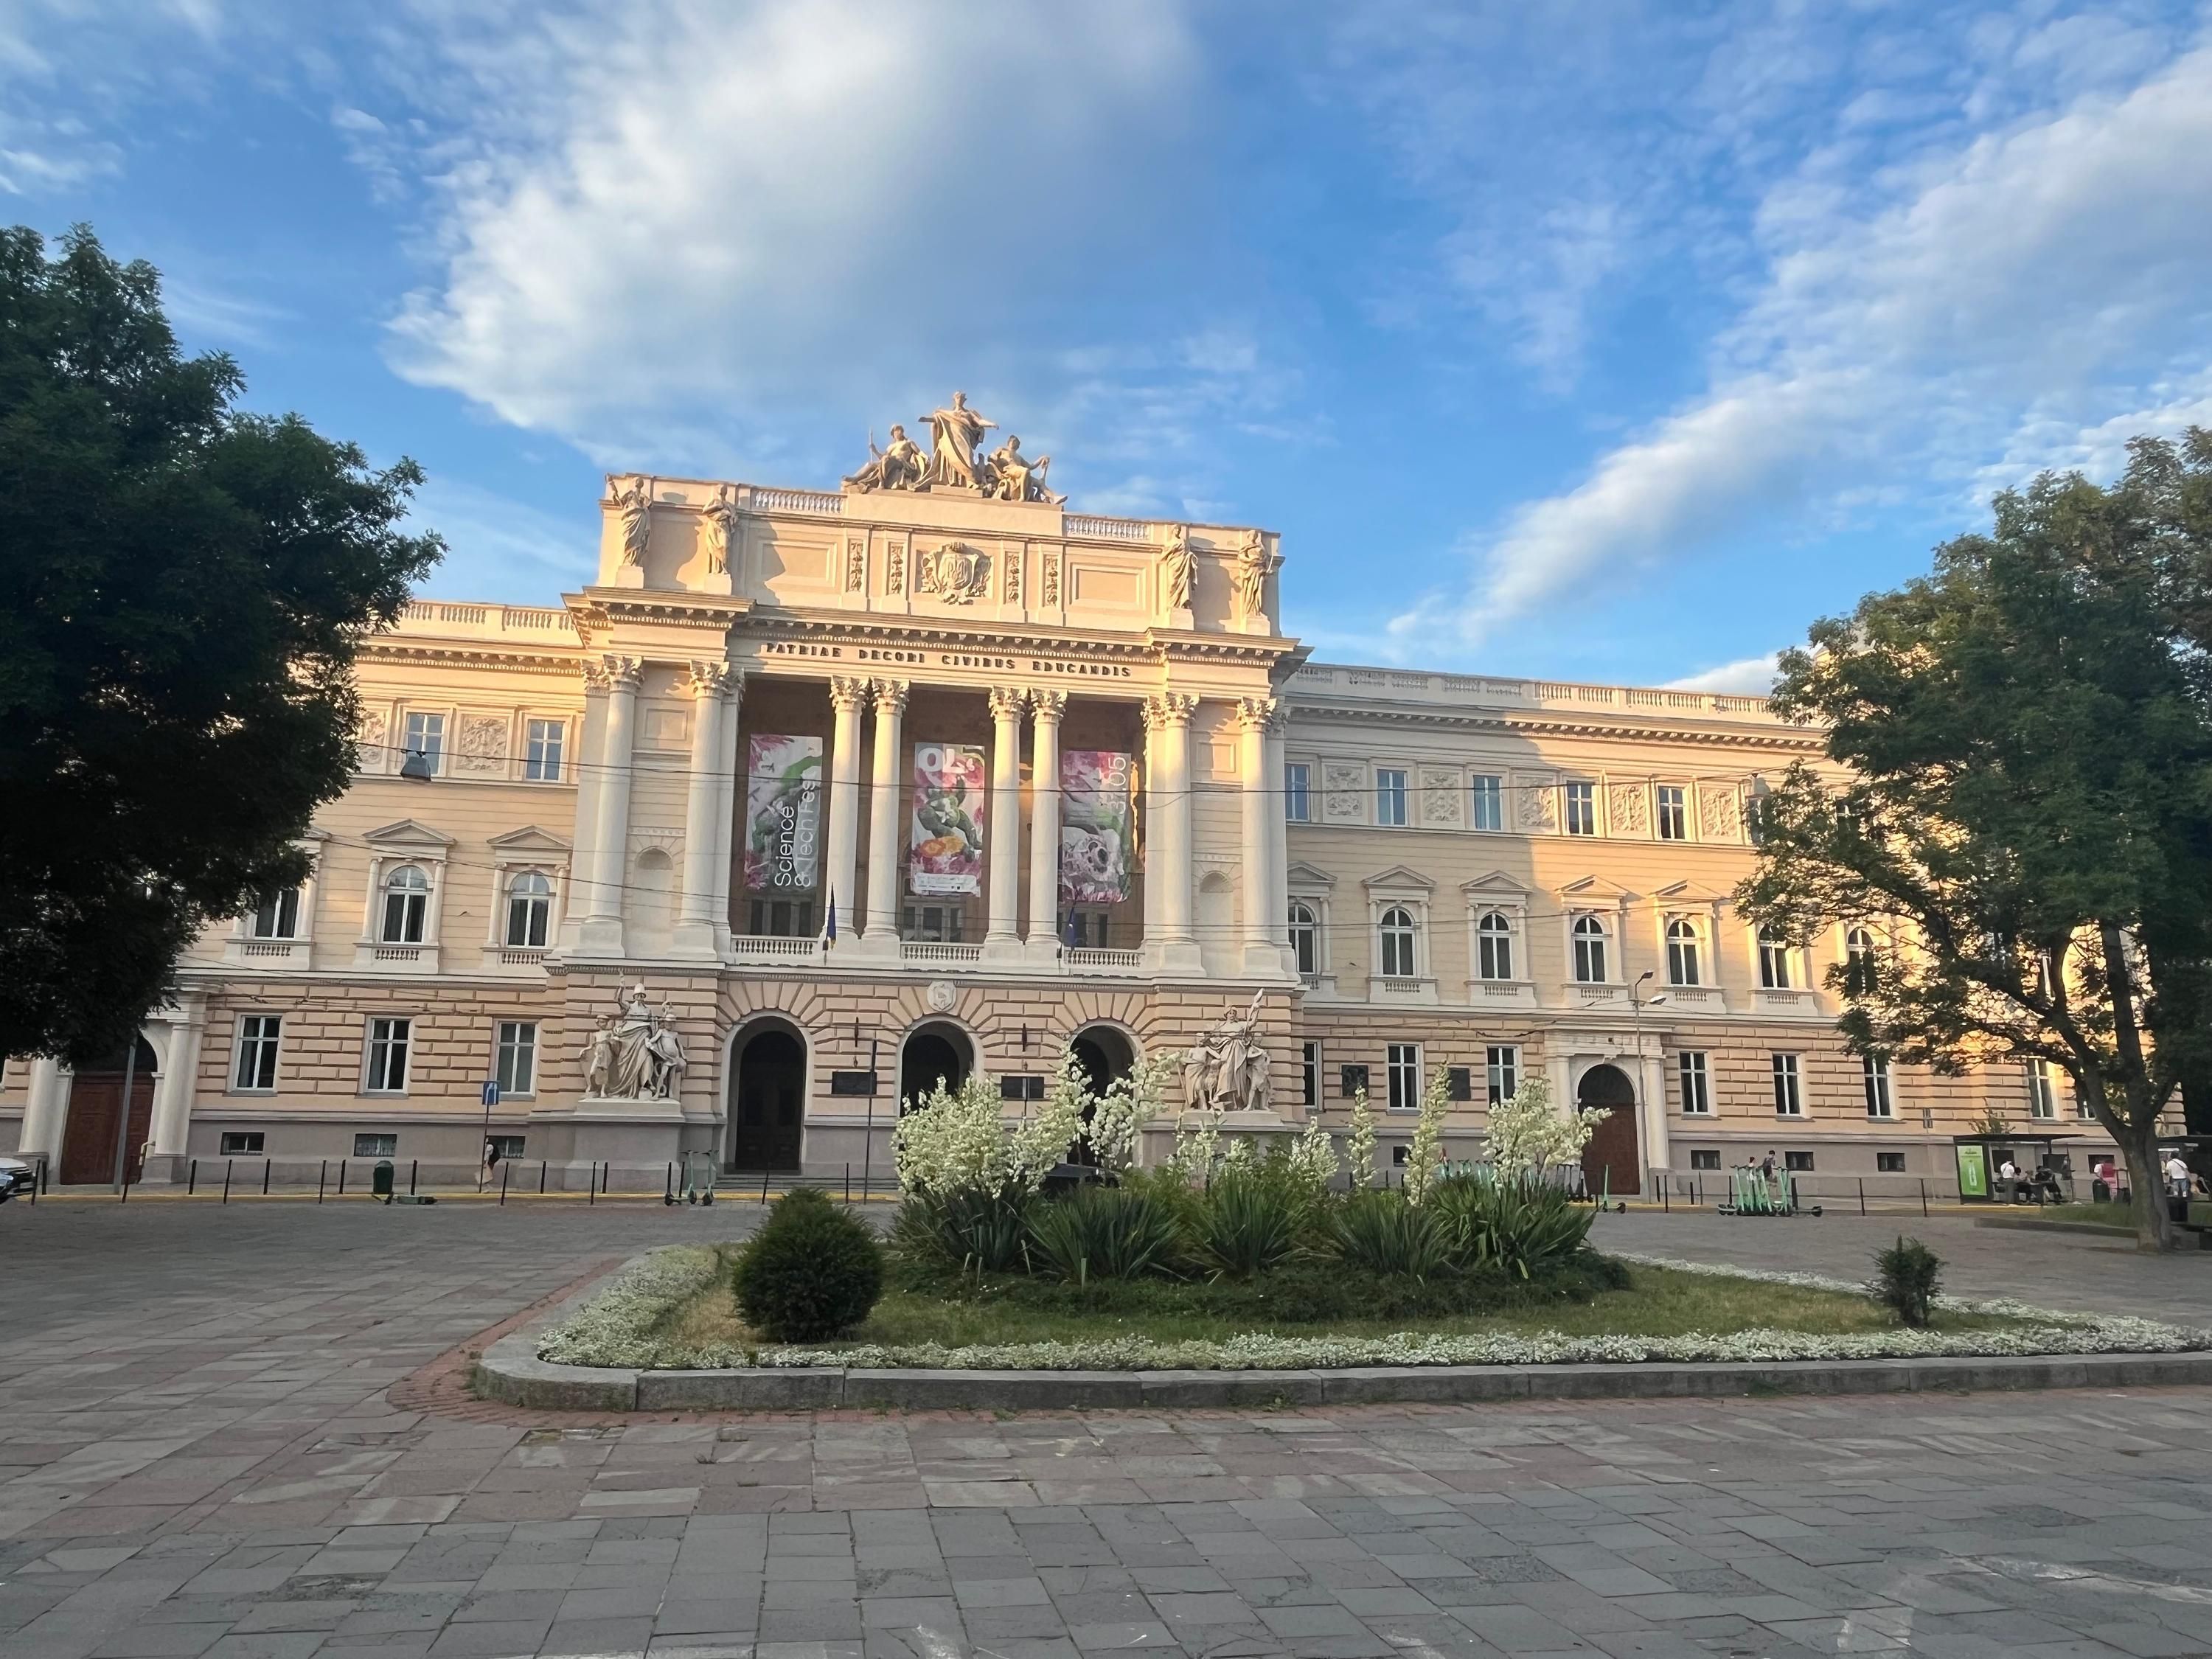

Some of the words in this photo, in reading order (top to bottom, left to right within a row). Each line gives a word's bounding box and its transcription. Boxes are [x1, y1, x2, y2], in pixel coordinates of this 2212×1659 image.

[766, 642, 842, 658] PATRIAE
[858, 649, 925, 663] DECORI
[941, 655, 1015, 669] CIVIBUS
[1032, 661, 1132, 677] EDUCANDIS
[797, 770, 815, 813] Fes
[774, 805, 794, 886] Science
[796, 819, 814, 866] Tech
[794, 872, 811, 887] &
